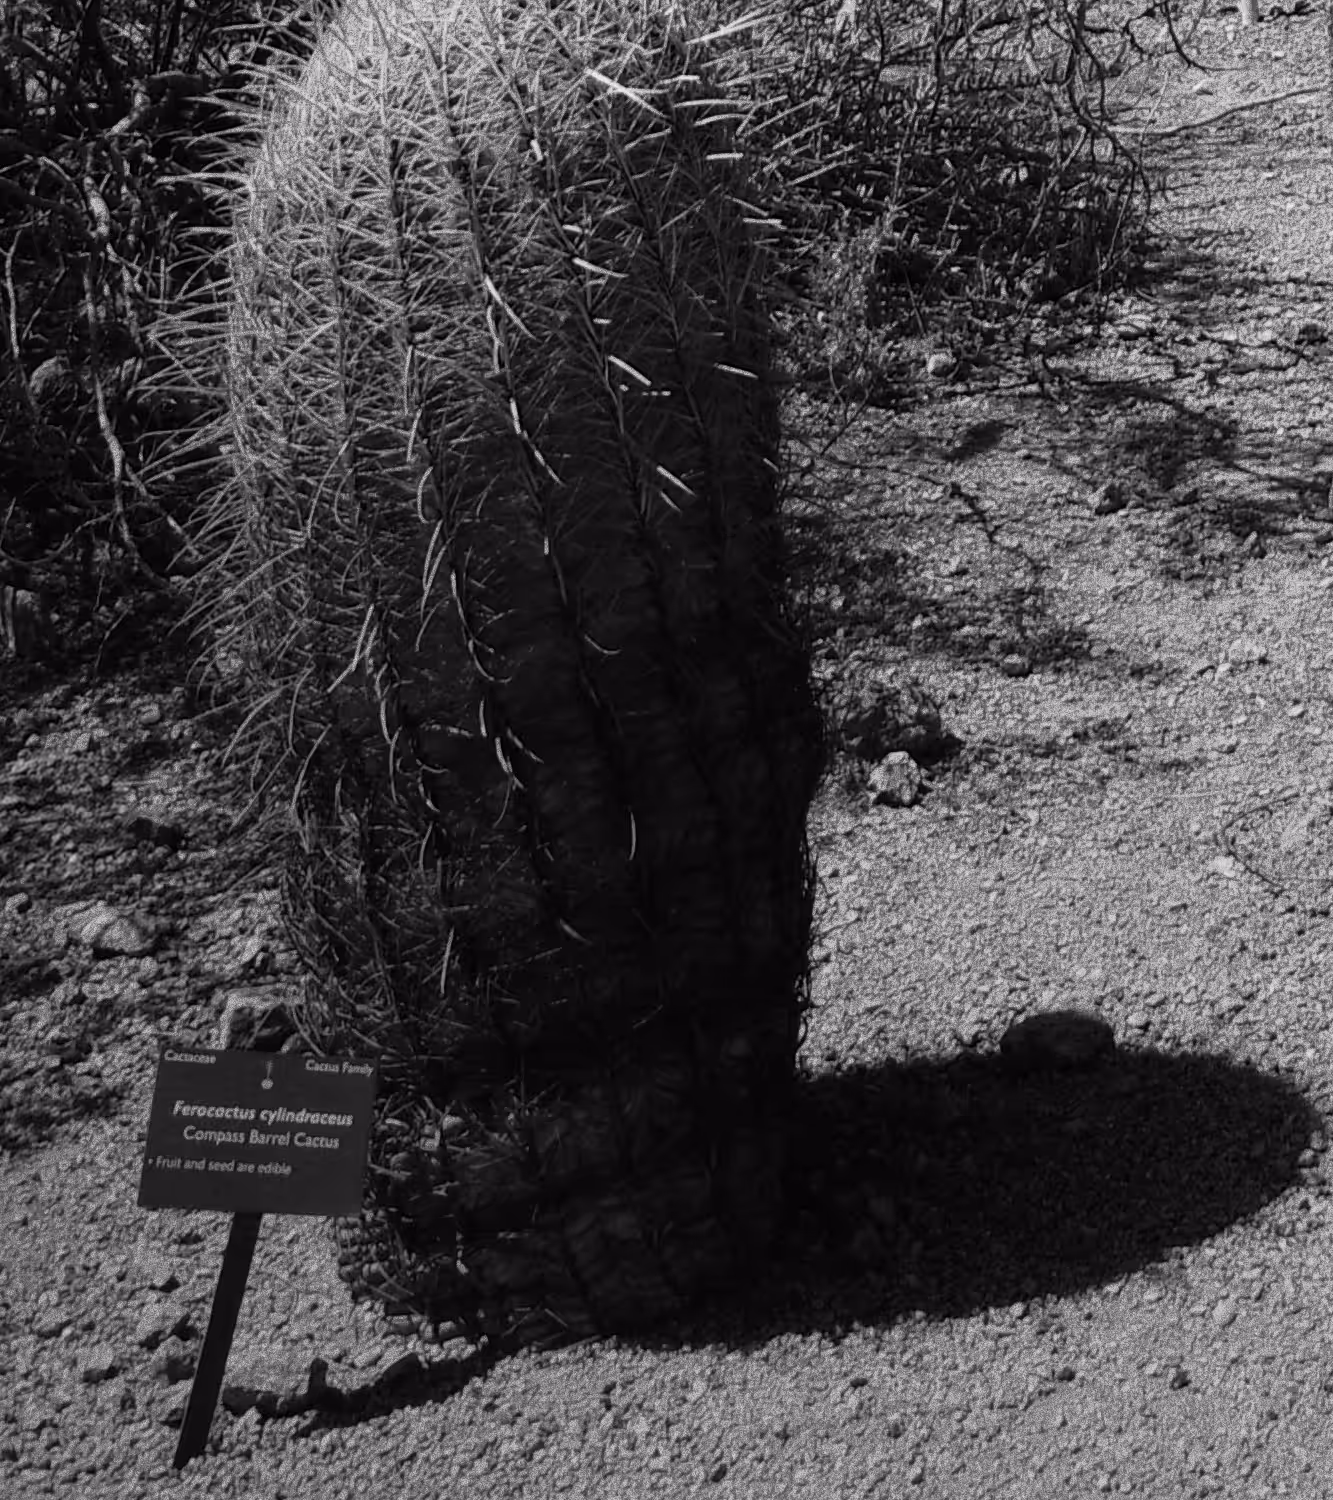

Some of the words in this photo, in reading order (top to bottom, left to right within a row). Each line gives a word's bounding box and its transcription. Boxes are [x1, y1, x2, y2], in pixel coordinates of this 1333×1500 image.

[305, 1060, 339, 1073] Cactus
[342, 1063, 374, 1077] Family
[173, 1101, 255, 1120] Ferocactus
[260, 1107, 354, 1126] cylindraceus
[183, 1126, 245, 1145] Compass
[250, 1129, 290, 1146] Barrel
[294, 1133, 339, 1149] Cactus
[156, 1158, 181, 1169] Fruit
[184, 1160, 205, 1171] and
[208, 1161, 234, 1172] seed
[237, 1164, 254, 1173] are
[258, 1163, 292, 1176] edible
